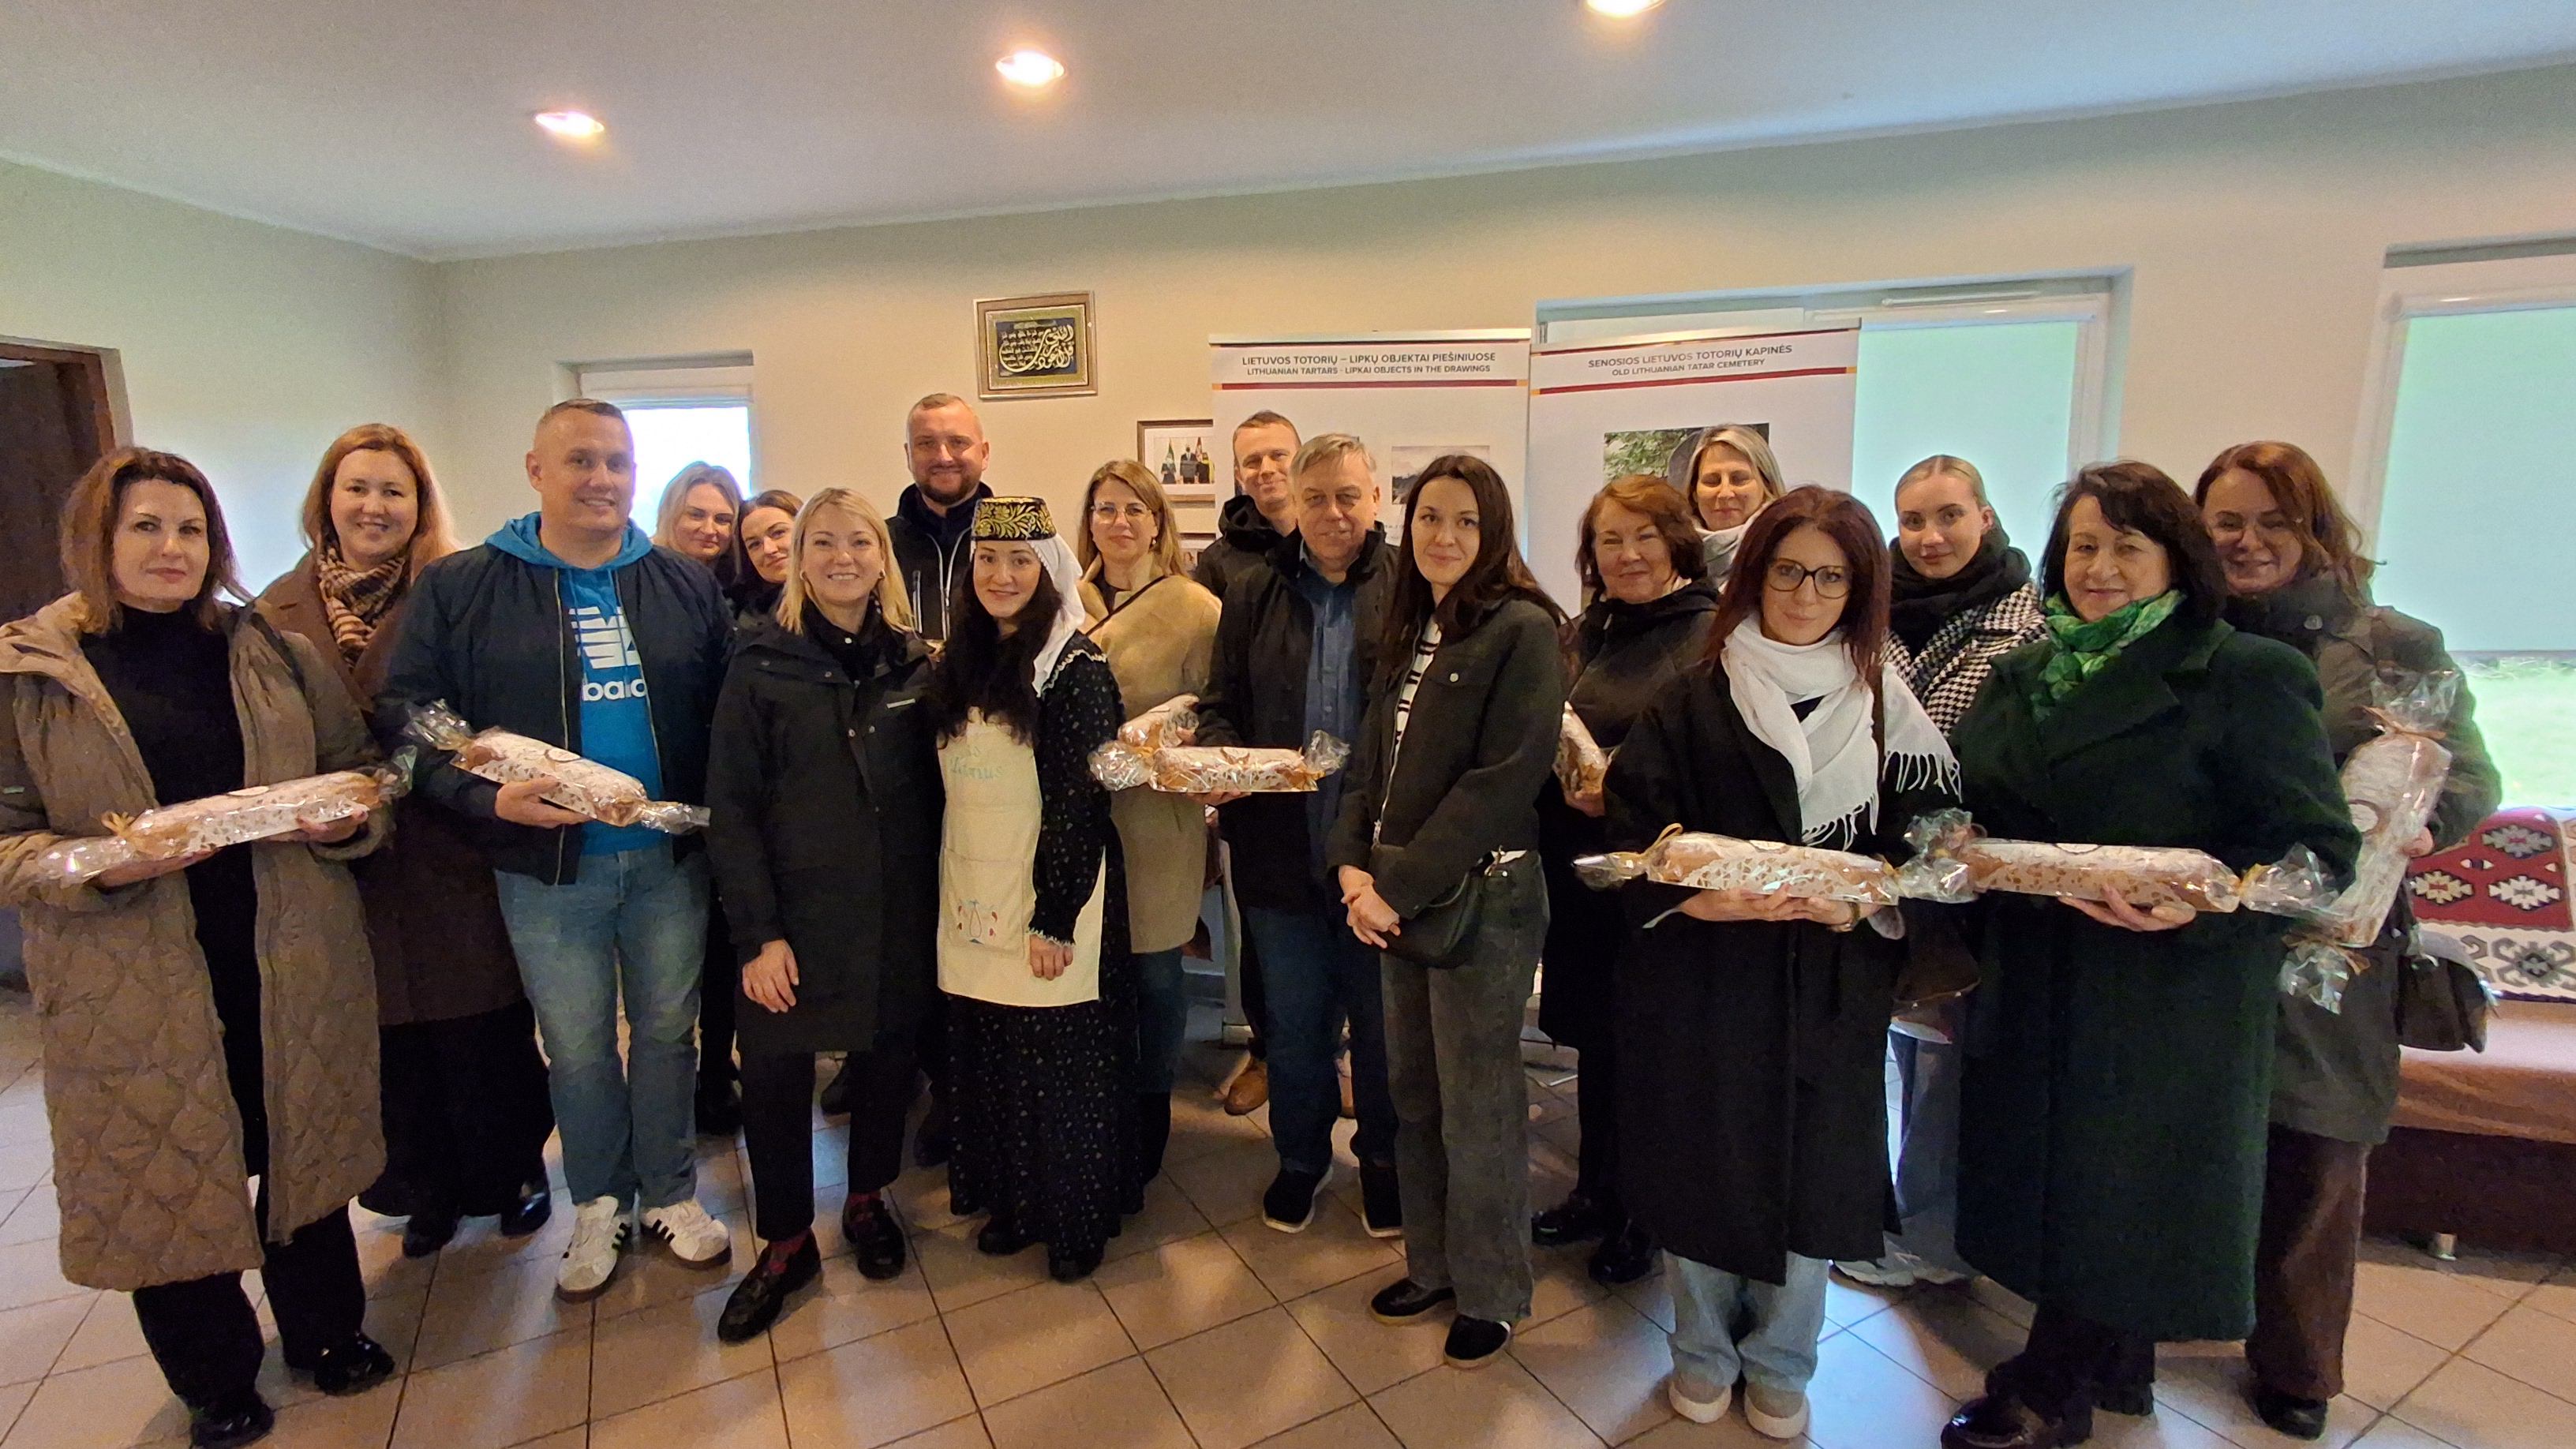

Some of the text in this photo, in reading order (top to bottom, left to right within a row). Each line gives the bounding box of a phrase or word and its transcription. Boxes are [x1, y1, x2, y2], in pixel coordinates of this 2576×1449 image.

[1242, 356, 1291, 365] LIETUVOS
[1294, 355, 1338, 365] TOTORIŲ
[1350, 354, 1379, 365] LIPKŲ
[1381, 354, 1429, 363] OBJEKTAI
[1432, 351, 1496, 362] PIEŠINIUOSE
[1588, 344, 1793, 368] SENOSIOS LIETUVOS TOTORIŲ KAPINĖS
[1374, 365, 1412, 374] OBJECTS
[1632, 364, 1685, 375] LITHUANIAN
[1717, 358, 1765, 369] CEMETERY
